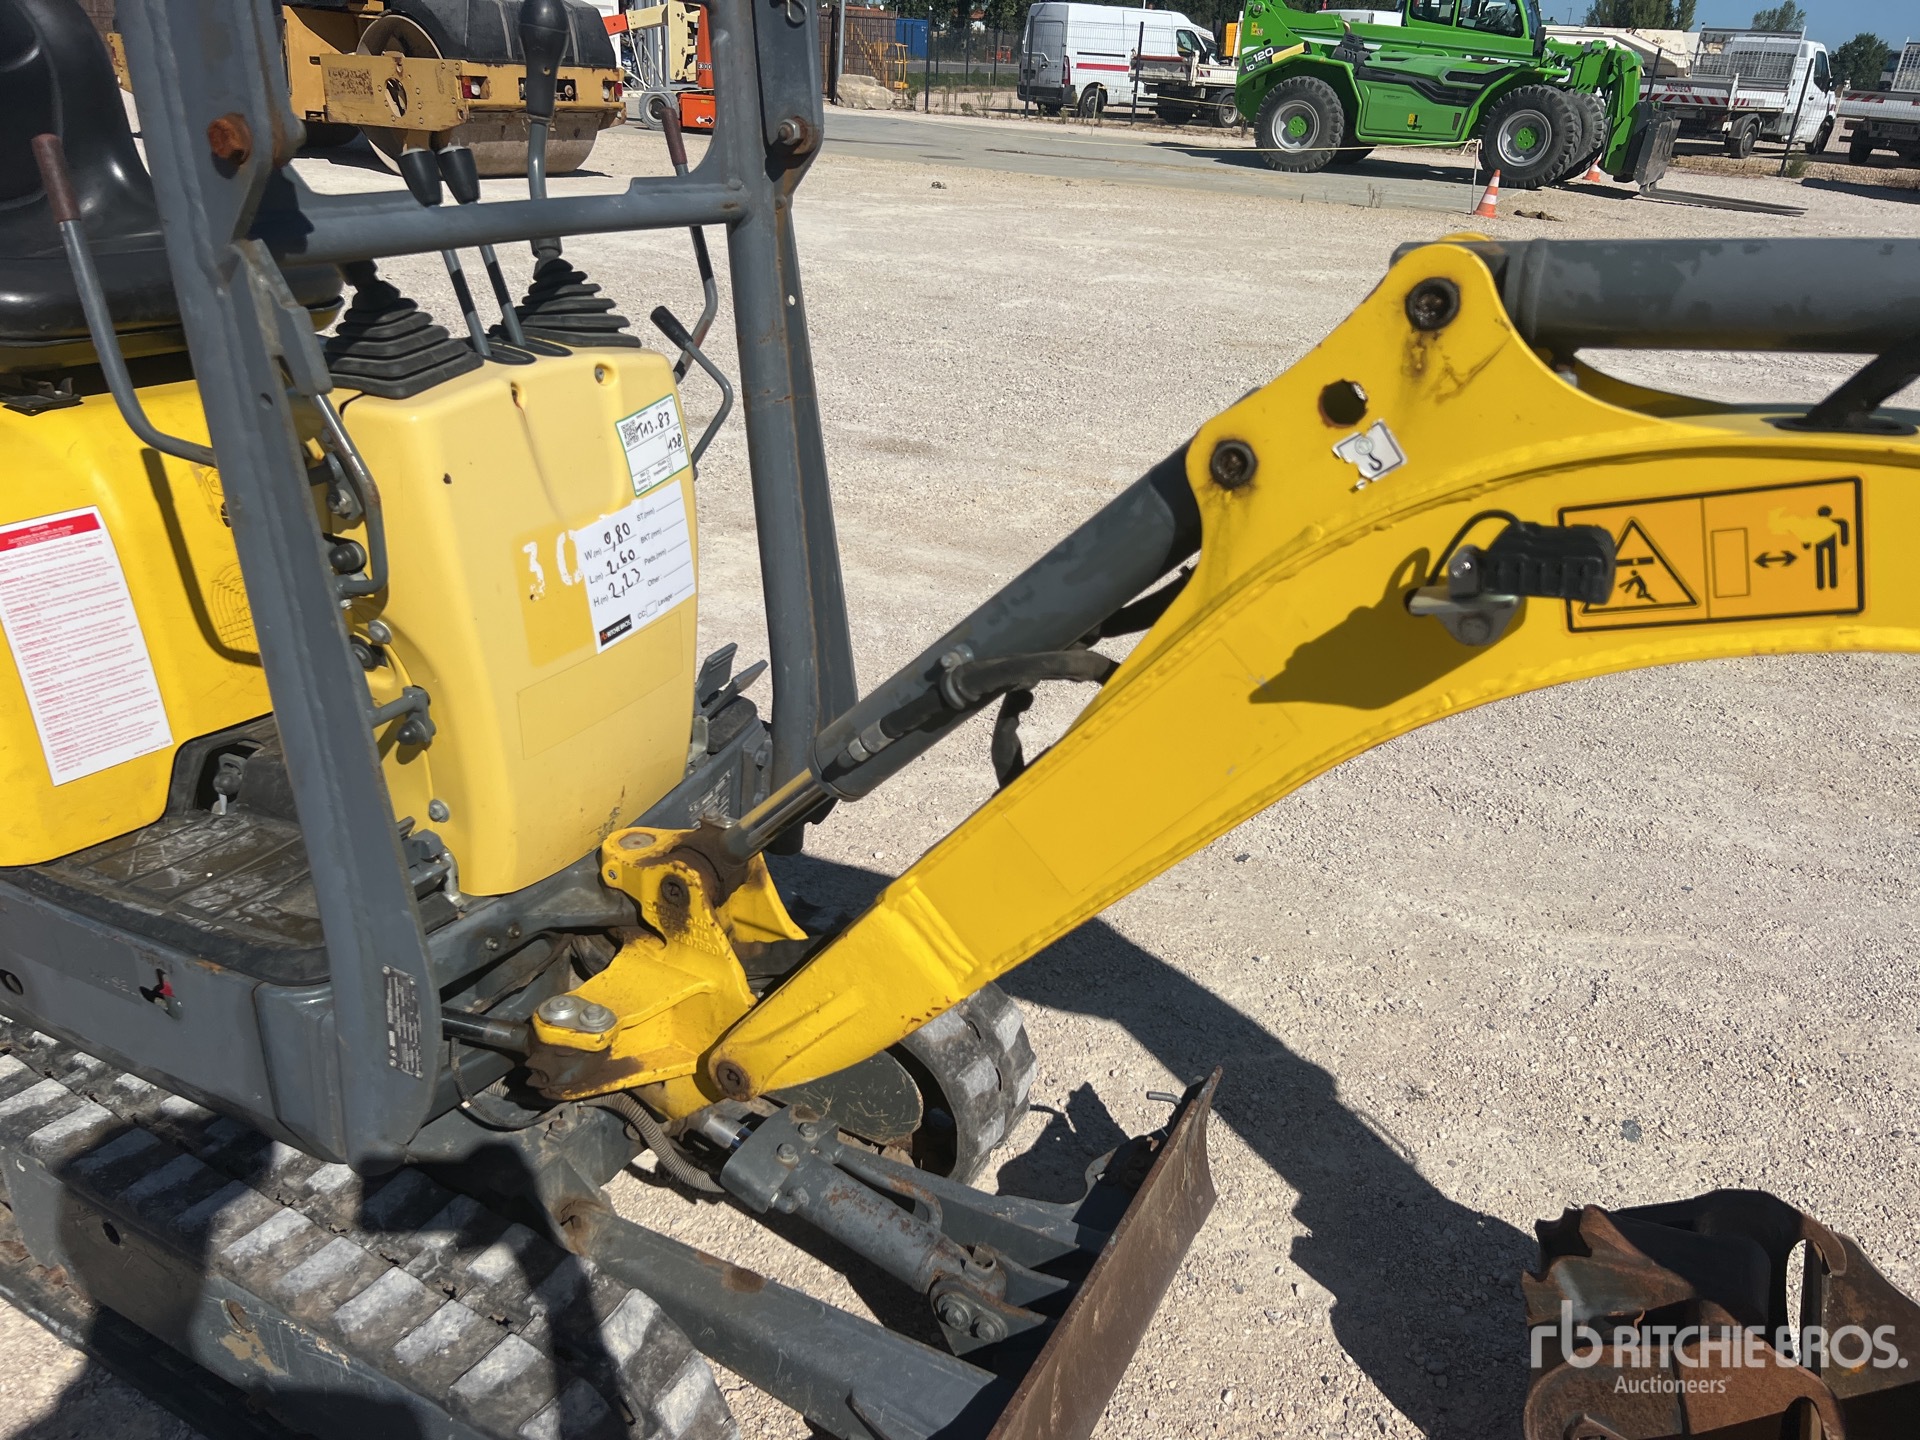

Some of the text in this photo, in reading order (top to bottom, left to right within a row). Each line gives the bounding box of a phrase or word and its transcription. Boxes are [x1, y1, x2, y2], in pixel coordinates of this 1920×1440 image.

[1244, 46, 1274, 66] P120
[668, 433, 682, 450] 138
[603, 521, 631, 552] 0,80
[606, 549, 635, 575] 2,60
[608, 568, 641, 599] 2,23
